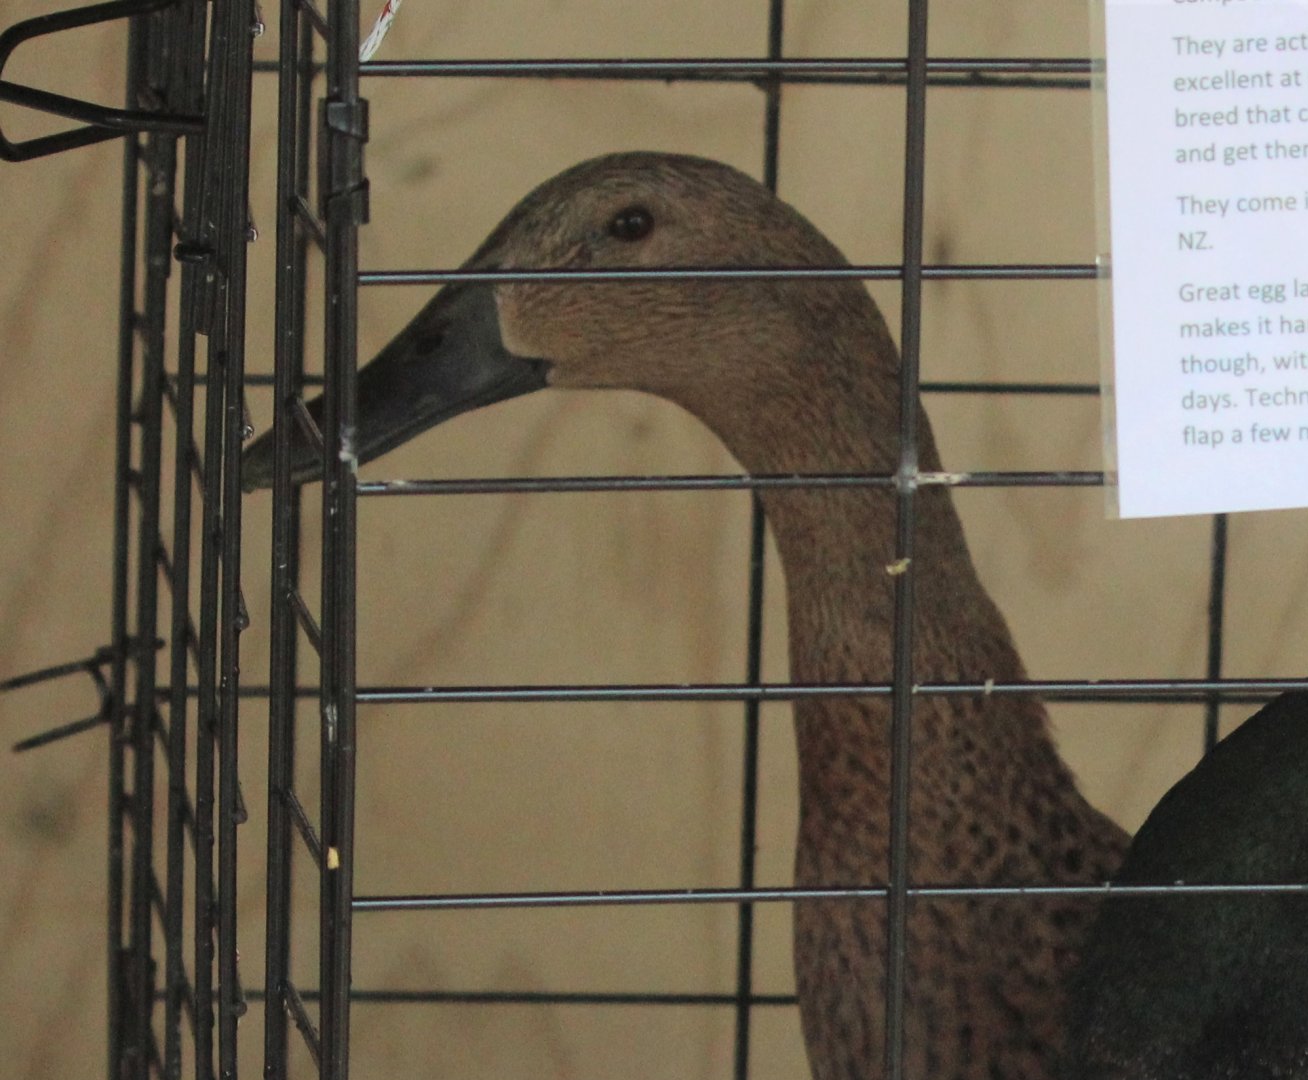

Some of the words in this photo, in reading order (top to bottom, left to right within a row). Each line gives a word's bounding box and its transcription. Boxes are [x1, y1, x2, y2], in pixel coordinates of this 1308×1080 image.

[1172, 35, 1226, 58] They
[1233, 37, 1268, 54] are
[1173, 69, 1273, 92] excellent
[1280, 69, 1301, 88] at
[1175, 105, 1239, 128] breed
[1246, 104, 1291, 125] that
[1175, 142, 1216, 164] and
[1223, 143, 1258, 167] get
[1176, 194, 1230, 218] They
[1236, 196, 1297, 213] come
[1178, 230, 1213, 251] NZ.
[1178, 282, 1240, 303] Great
[1248, 283, 1287, 304] egg
[1180, 317, 1251, 338] makes
[1258, 315, 1272, 335] it
[1180, 351, 1265, 377] though,
[1181, 389, 1237, 413] days.
[1182, 424, 1224, 449] flap
[1231, 428, 1243, 444] a
[1250, 421, 1291, 444] few
